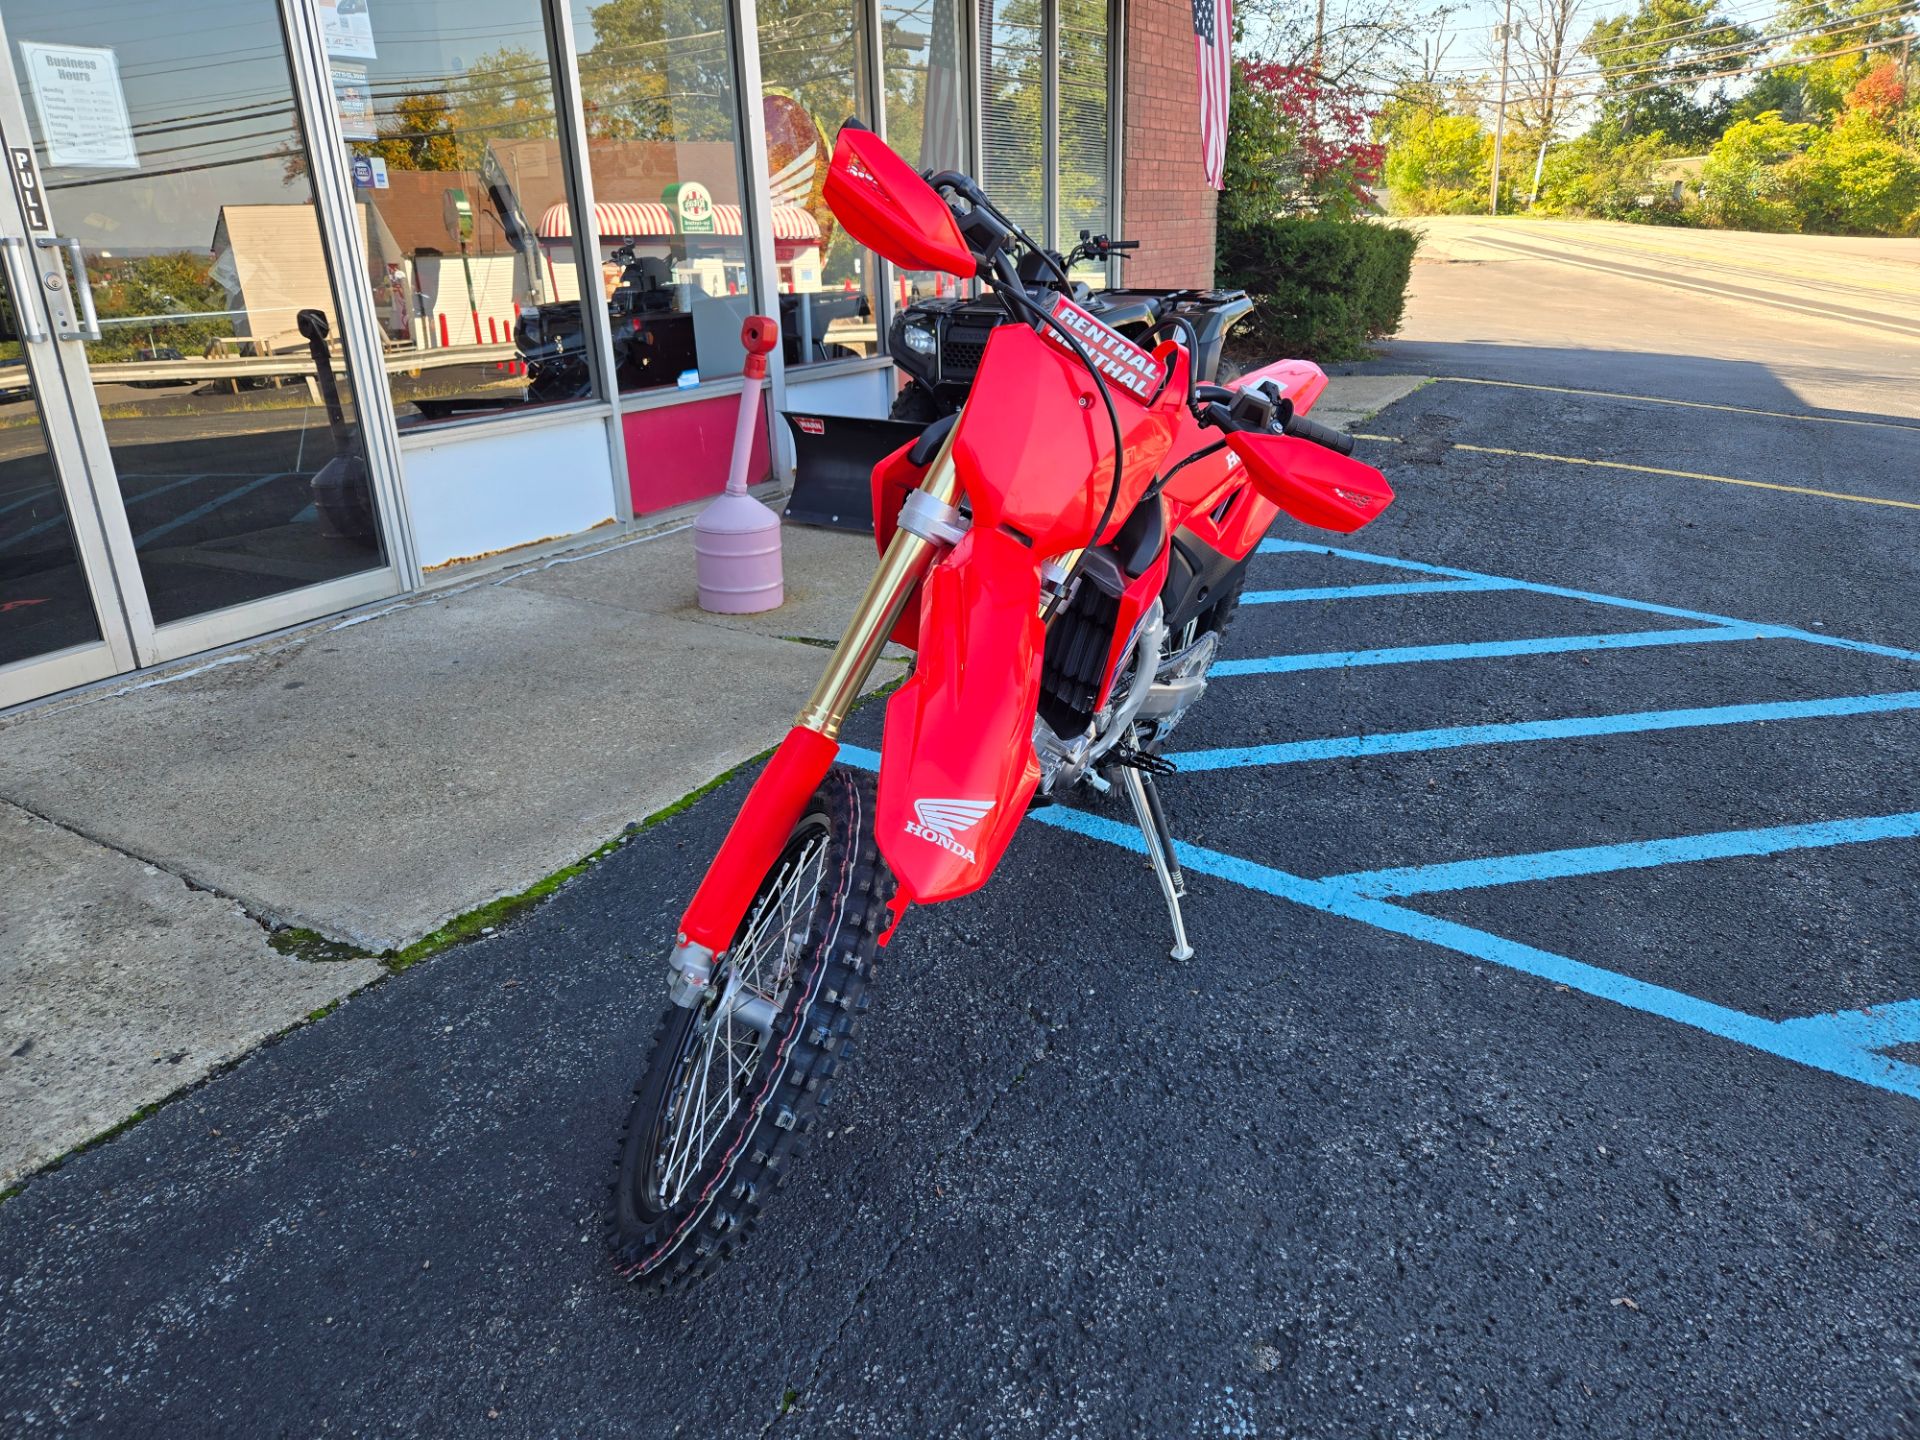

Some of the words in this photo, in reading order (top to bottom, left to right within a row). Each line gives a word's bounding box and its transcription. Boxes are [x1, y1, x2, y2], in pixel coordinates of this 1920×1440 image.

[45, 55, 97, 70] Business
[57, 69, 91, 82] Hours
[15, 152, 43, 227] PULL
[1058, 307, 1157, 380] RENTHAL
[904, 820, 976, 865] HONDA
